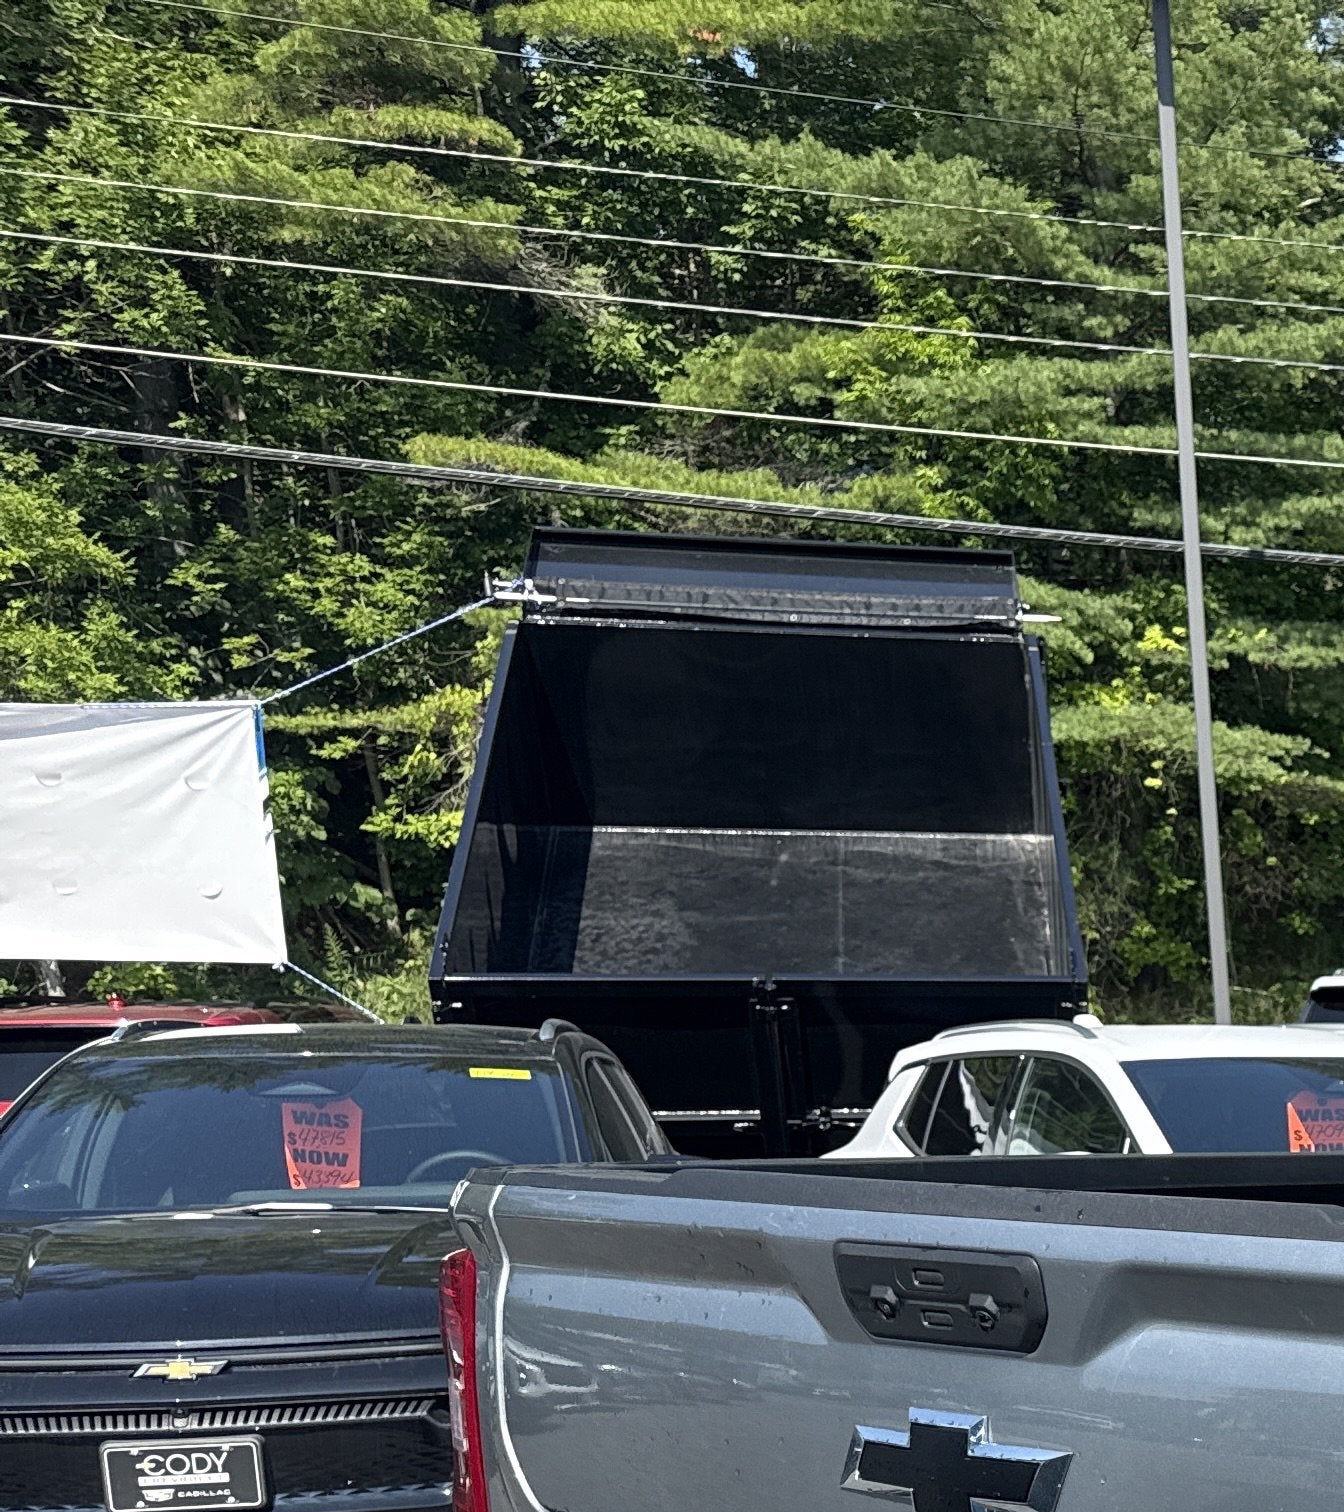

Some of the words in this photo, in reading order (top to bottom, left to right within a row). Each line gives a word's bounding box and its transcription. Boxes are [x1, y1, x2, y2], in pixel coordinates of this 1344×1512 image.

[291, 1110, 350, 1129] WAS
[292, 1148, 349, 1167] NOW
[141, 1452, 228, 1476] CODY
[177, 1488, 231, 1497] CADILLAC
